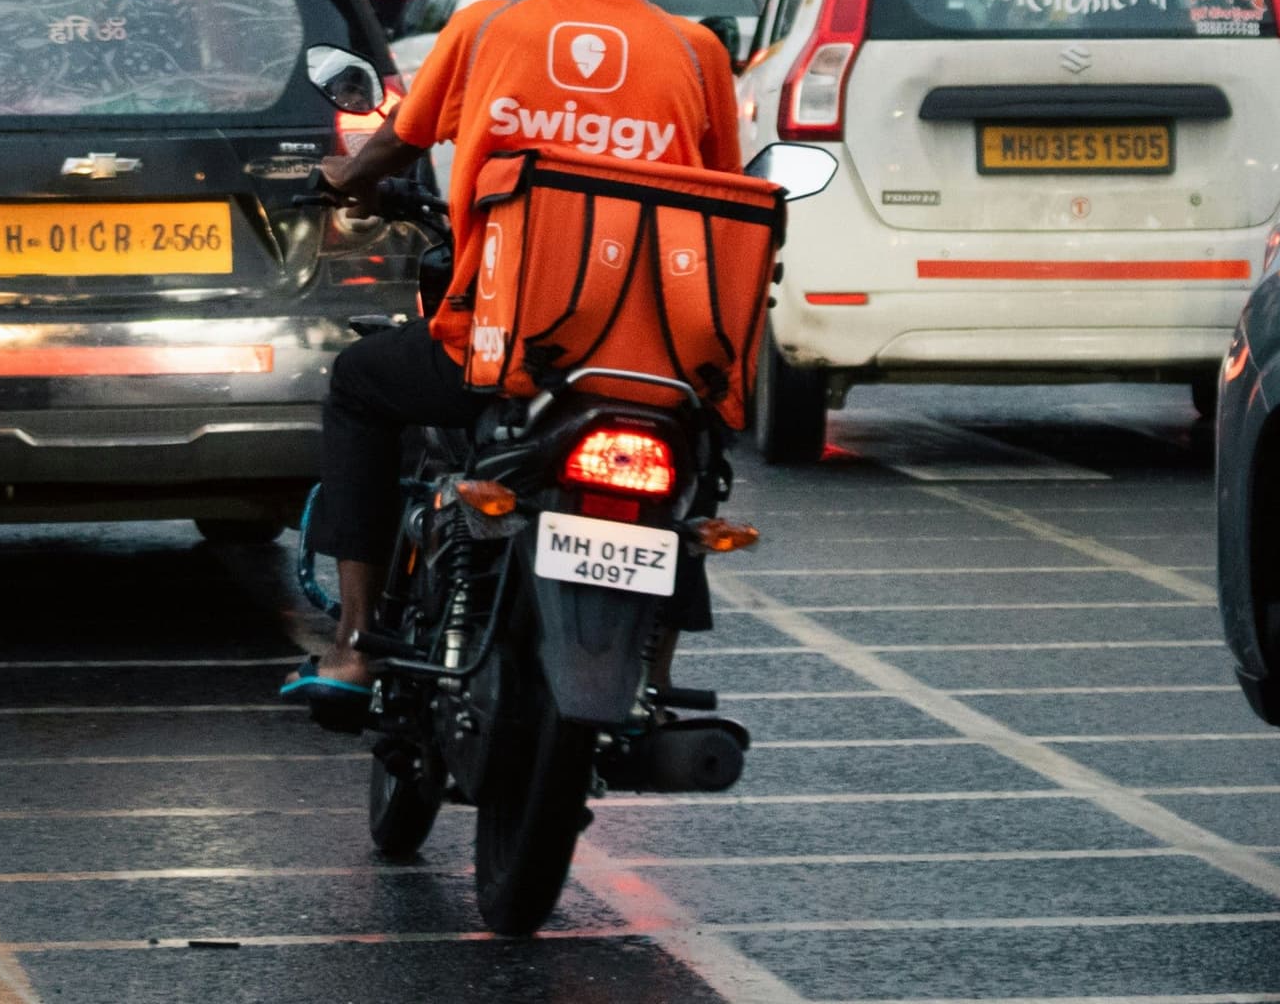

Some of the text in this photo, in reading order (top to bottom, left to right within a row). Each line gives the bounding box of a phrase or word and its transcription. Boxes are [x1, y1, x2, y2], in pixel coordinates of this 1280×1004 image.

[489, 96, 676, 161] Swiggy
[152, 222, 222, 252] 2566
[550, 533, 667, 570] MH 01EZ
[574, 561, 638, 586] 4097
